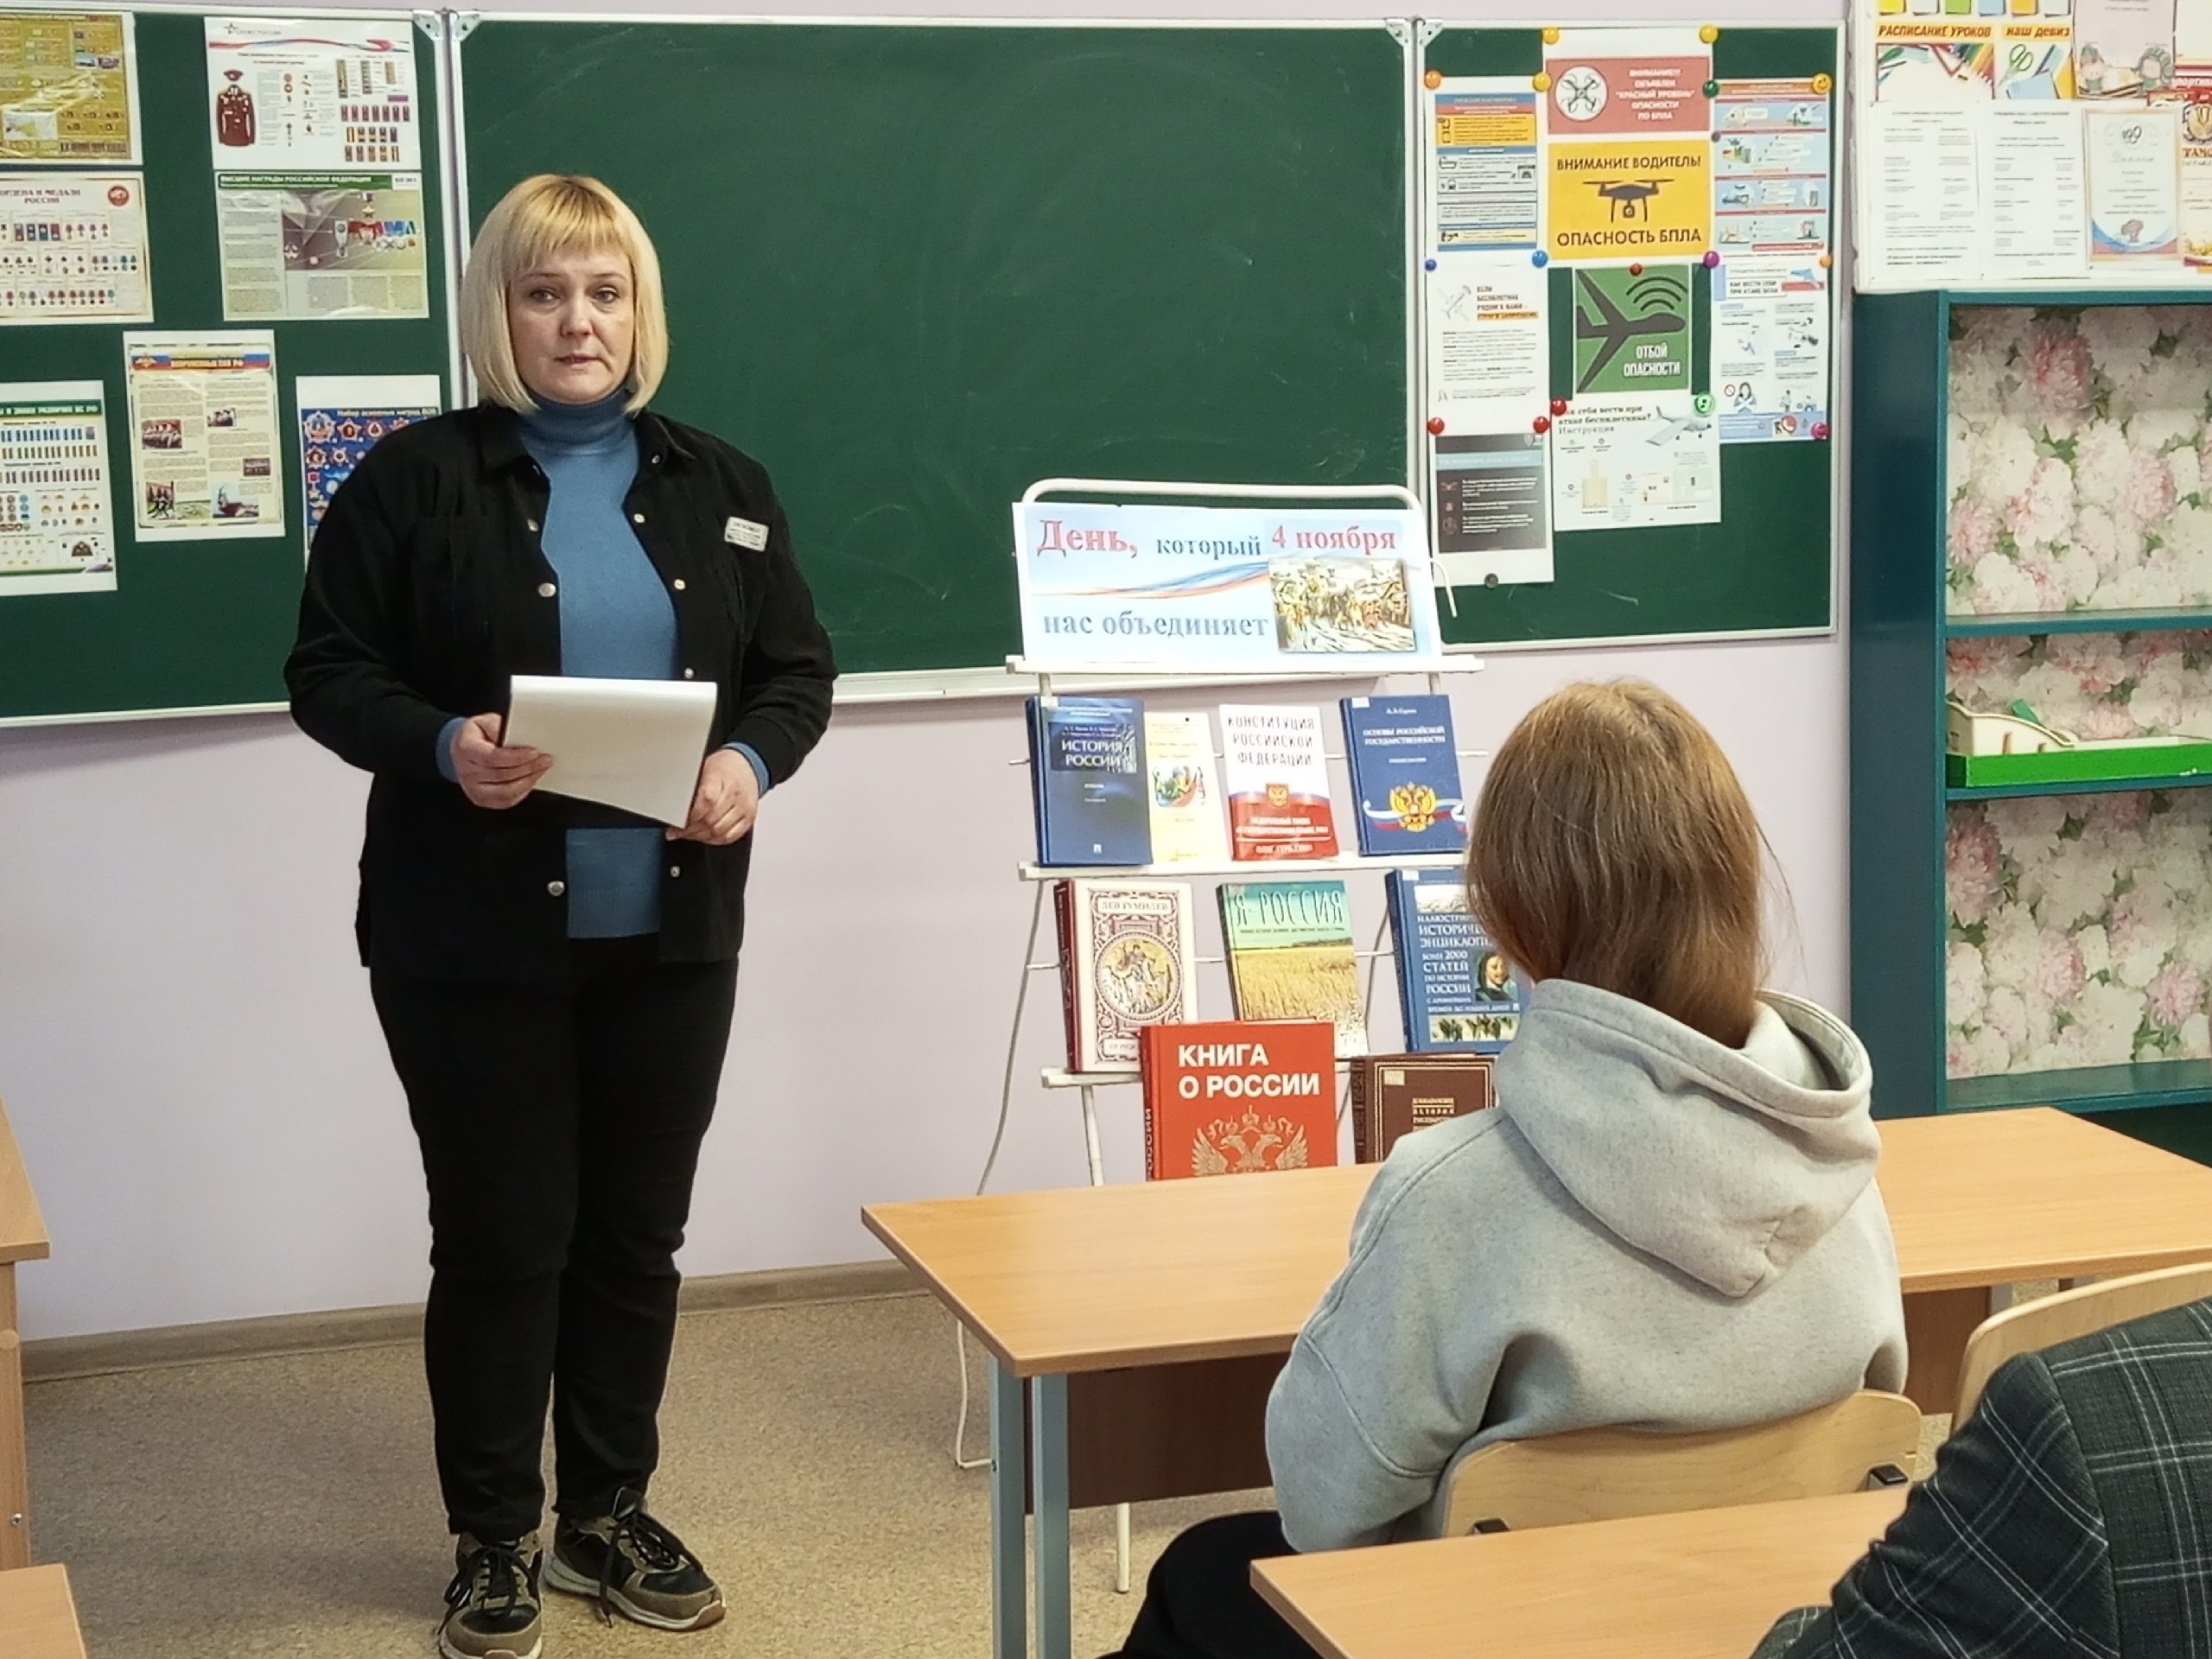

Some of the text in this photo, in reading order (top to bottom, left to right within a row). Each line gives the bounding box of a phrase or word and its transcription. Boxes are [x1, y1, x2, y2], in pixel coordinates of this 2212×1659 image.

[1878, 25, 1992, 37] РАСПИСАНИЕ УРОКОВ
[1557, 156, 1700, 170] ВНИМАНИЕ ВОДИТЕЛЬ!
[1557, 228, 1701, 246] ОПАСНОСТЬ БПЛА
[1636, 342, 1668, 359] ОТБОЙ
[1624, 361, 1681, 377] ОПАСНОСТИ
[1625, 406, 1643, 416] при
[1559, 426, 1614, 435] Инструкция
[1037, 519, 1395, 561] День, который 4 ноября
[1043, 610, 1268, 639] нас объединяет
[1228, 716, 1315, 730] КОНСТИТУЦИЯ
[1396, 725, 1444, 735] РОССИЙСКОЙ
[1061, 739, 1123, 753] ИСТОРИЯ
[1364, 735, 1445, 746] ГОСУДАРСТВЕННОСТИ
[1065, 754, 1121, 767] РОССИИ
[1237, 752, 1312, 766] ФЕДЕРАЦИИ
[1235, 890, 1343, 926] Я РОССИЯ
[1445, 950, 1468, 959] 2000
[1423, 962, 1469, 972] СТАТЕЙ
[1427, 983, 1471, 994] РОССИИ
[1178, 1043, 1269, 1068] КНИГА
[1179, 1073, 1320, 1099] О РОССИИ
